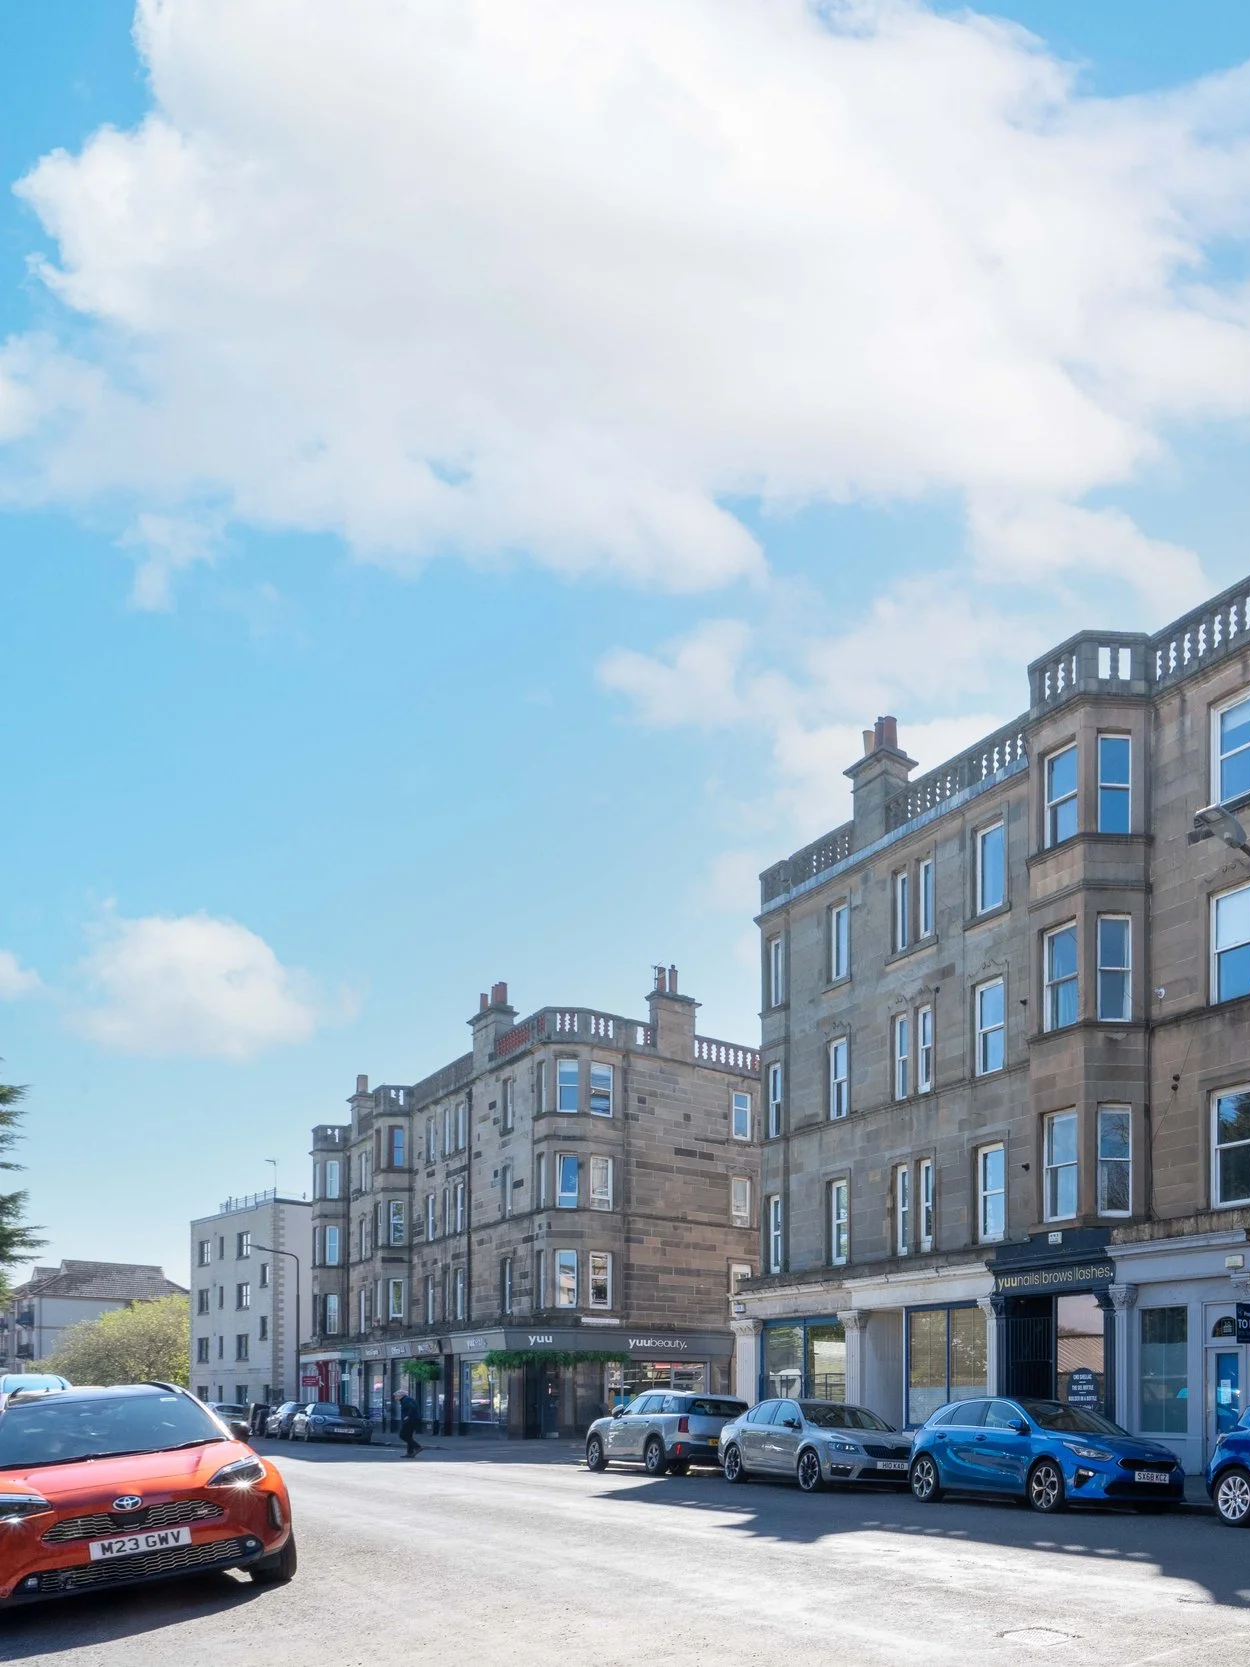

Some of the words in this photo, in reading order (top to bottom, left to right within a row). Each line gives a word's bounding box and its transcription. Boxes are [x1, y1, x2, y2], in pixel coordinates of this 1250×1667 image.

[1238, 1319, 1248, 1329] TO
[528, 1334, 552, 1346] yuu
[101, 1538, 140, 1556] M23
[145, 1530, 181, 1548] GWV
